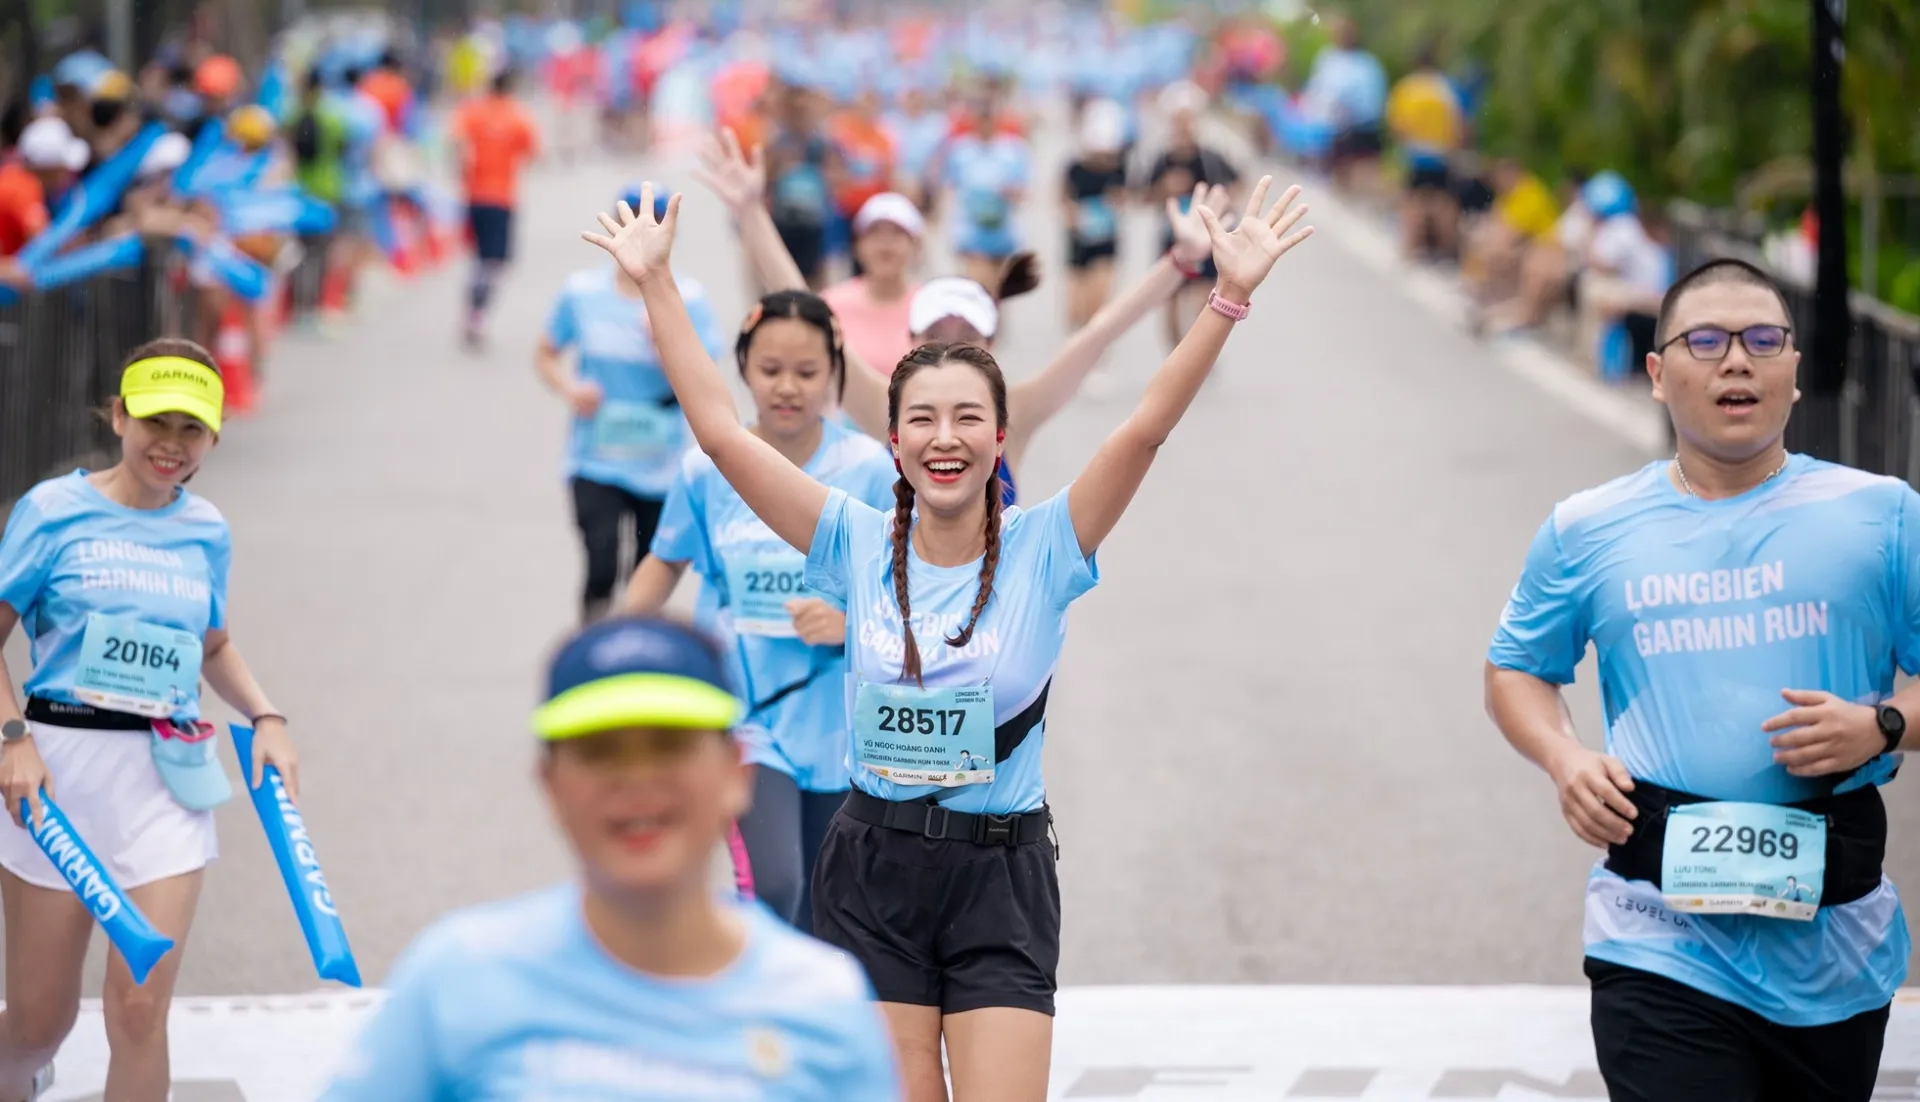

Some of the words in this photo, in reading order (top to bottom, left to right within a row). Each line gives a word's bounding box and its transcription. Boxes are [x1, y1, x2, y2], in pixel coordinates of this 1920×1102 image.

[151, 370, 208, 388] GARMIN
[82, 567, 168, 595] GARMIN
[173, 575, 209, 603] RUN
[743, 570, 811, 593] 2202
[1624, 559, 1784, 611] LONGBIEN
[1632, 614, 1757, 658] GARMIN
[1763, 601, 1828, 644] RUN
[103, 637, 180, 673] 20164
[49, 702, 95, 716] GARMIN
[877, 706, 966, 736] 28517
[863, 752, 892, 762] LONGBIEN
[893, 756, 917, 765] GARMIN
[923, 746, 946, 754] OANH
[892, 771, 922, 780] GARMIN
[1690, 825, 1798, 860] 22969
[1615, 896, 1667, 922] LEVEL
